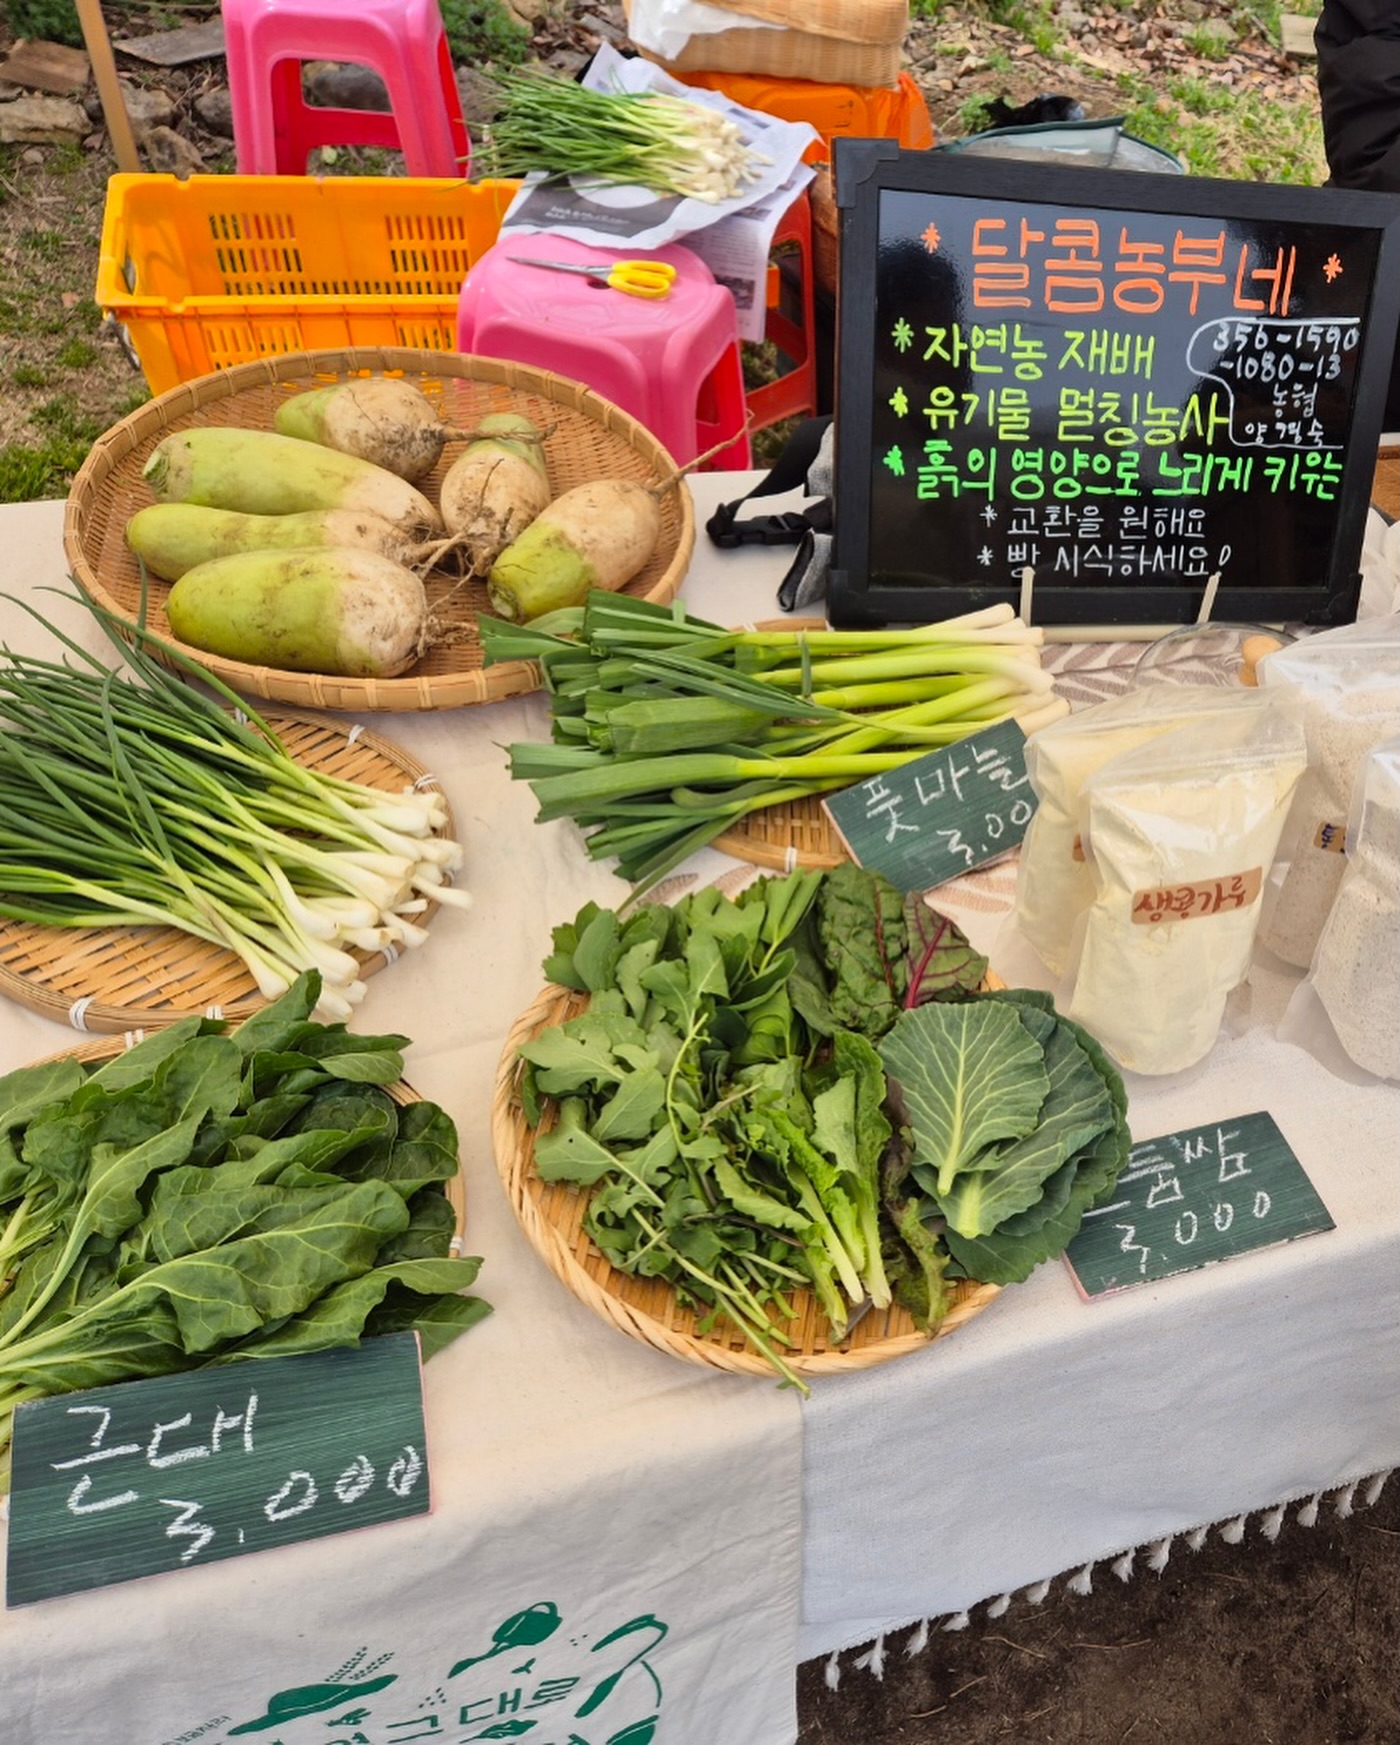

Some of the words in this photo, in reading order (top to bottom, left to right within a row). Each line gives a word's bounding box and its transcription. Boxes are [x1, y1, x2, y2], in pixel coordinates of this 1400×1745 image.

[972, 217, 1296, 317] 달콤농부네
[923, 322, 1048, 381] 자연농
[1058, 329, 1155, 379] 재배
[1213, 321, 1360, 353] 356-1590
[923, 386, 1032, 441] 유기물
[1057, 387, 1229, 446] 멀칭농사
[1272, 382, 1319, 418] 농협
[916, 439, 997, 501] 흙의
[1011, 448, 1142, 499] 영양으로
[1007, 505, 1104, 539] 교환을
[1119, 506, 1206, 539] 원해요
[1007, 542, 1040, 578] 빵
[862, 744, 1028, 843] 풋마늘
[1133, 875, 1247, 923] 생콩가루
[50, 1388, 258, 1515] 근대
